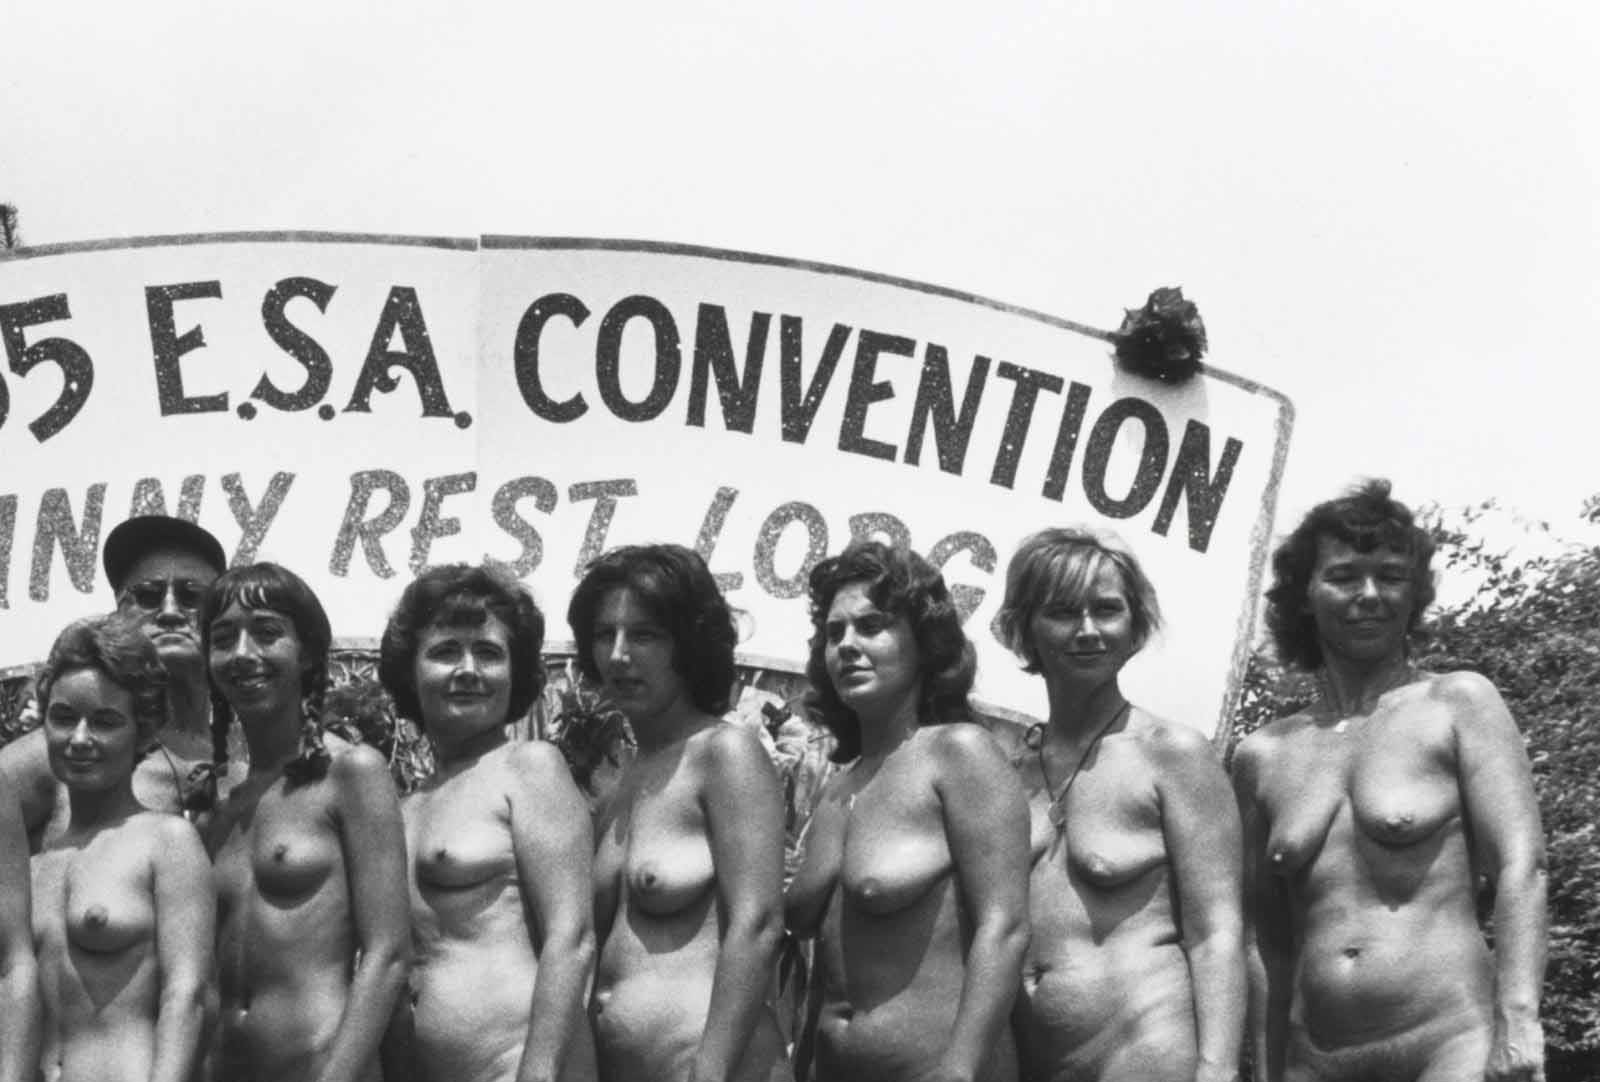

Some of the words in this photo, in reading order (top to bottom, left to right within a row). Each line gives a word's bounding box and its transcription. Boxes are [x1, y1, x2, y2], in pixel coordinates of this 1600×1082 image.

[144, 275, 474, 429] E.S.A.
[512, 292, 1245, 555] CONVENTION
[328, 468, 639, 580] REST
